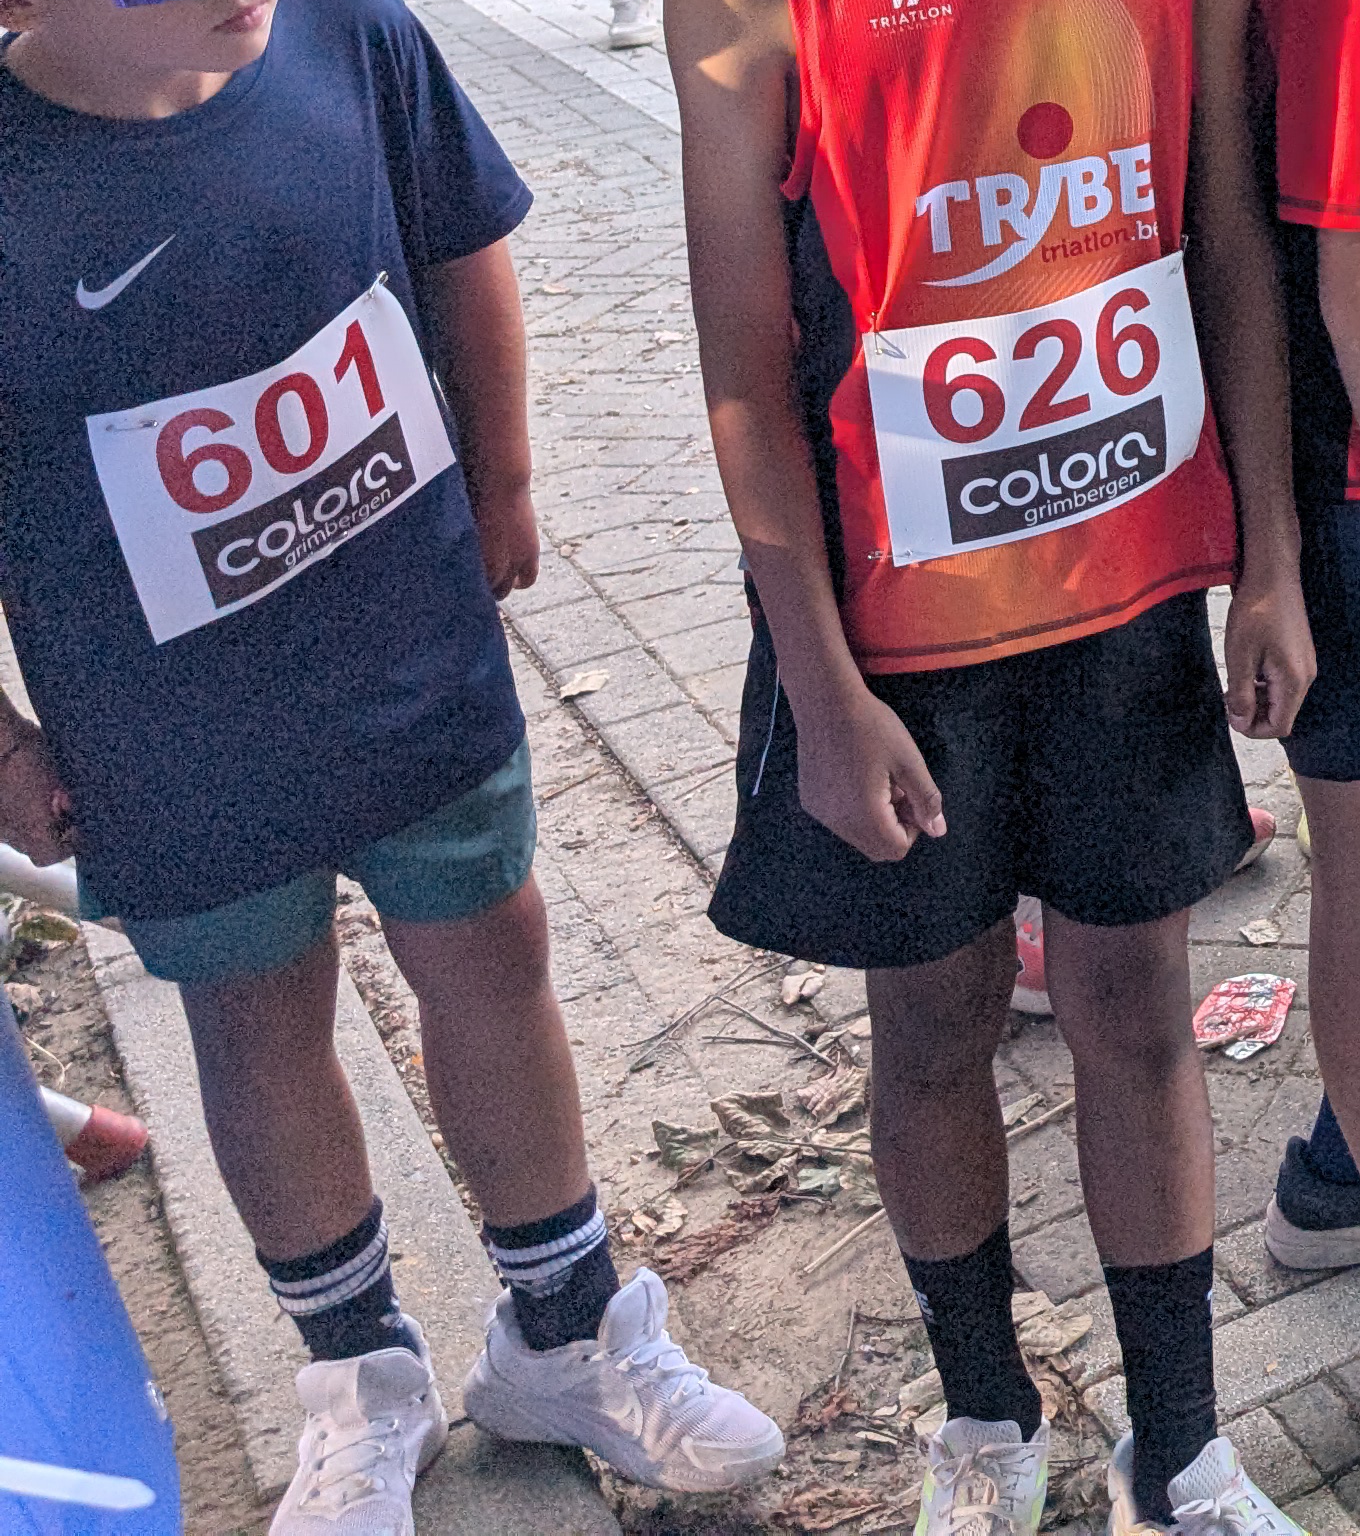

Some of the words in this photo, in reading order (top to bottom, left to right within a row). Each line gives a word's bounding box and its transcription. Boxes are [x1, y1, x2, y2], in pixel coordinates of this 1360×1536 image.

[868, 3, 953, 30] TRIATLON
[922, 287, 1161, 444] 626
[155, 318, 386, 515] 601
[217, 451, 402, 576] colora
[959, 431, 1157, 515] colora
[1024, 470, 1141, 527] grimbergen
[284, 488, 392, 571] grimbergen
